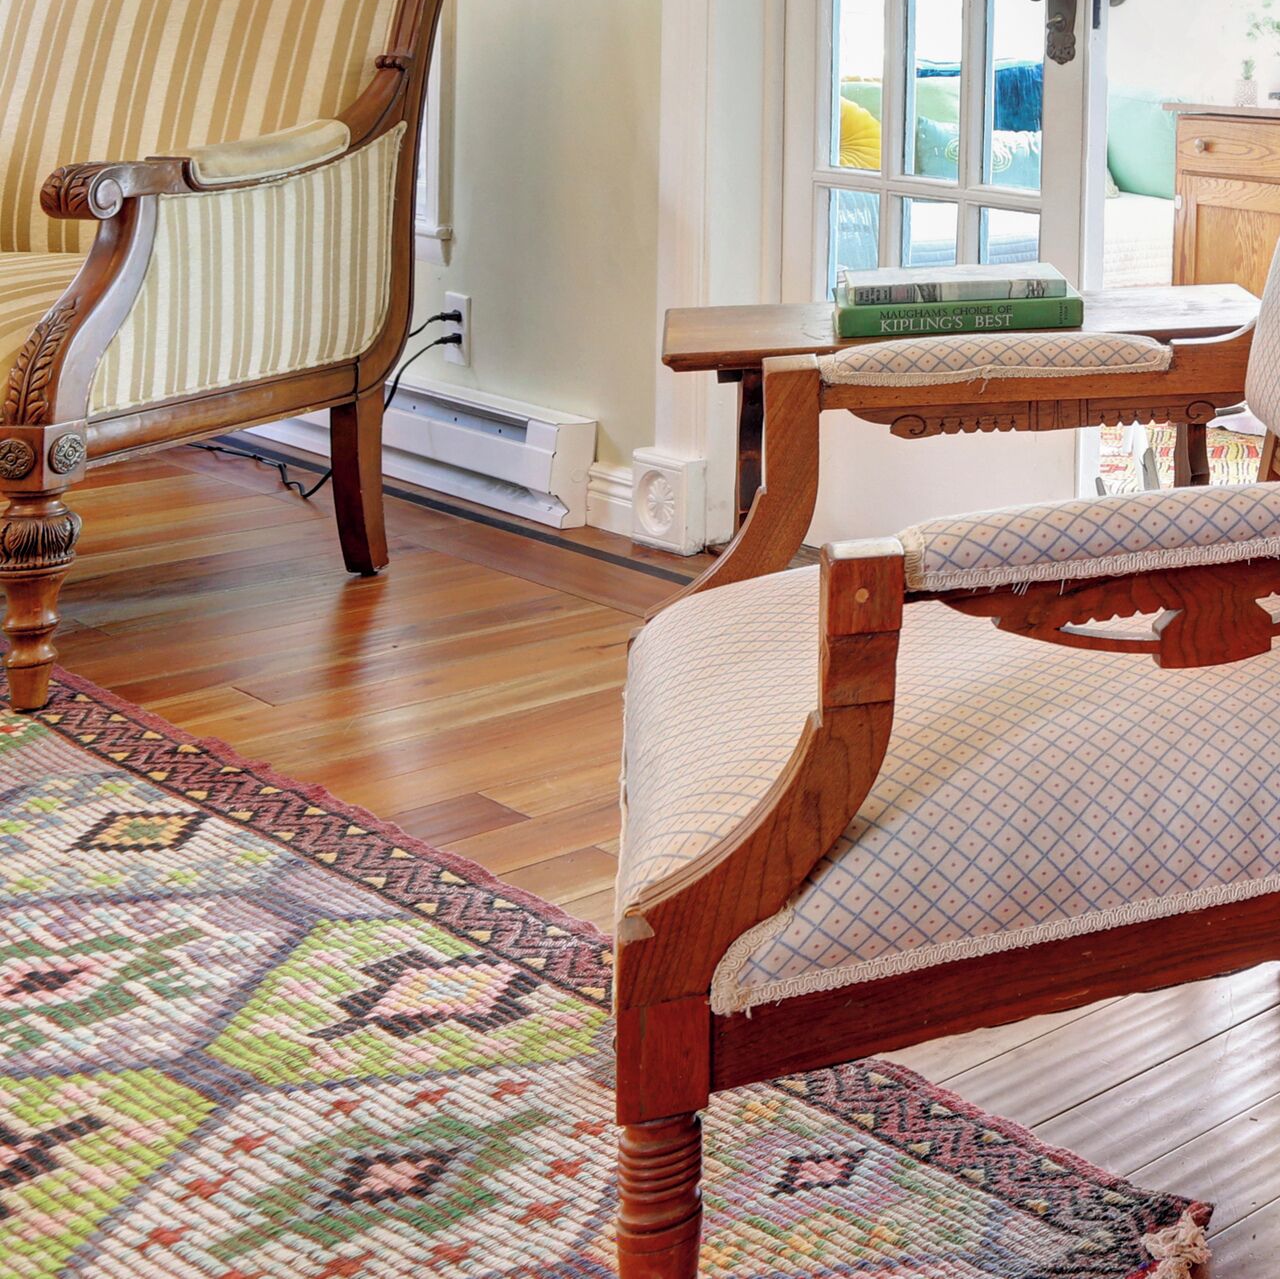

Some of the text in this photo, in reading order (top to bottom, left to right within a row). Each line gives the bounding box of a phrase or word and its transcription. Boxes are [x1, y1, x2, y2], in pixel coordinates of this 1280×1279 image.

[952, 305, 993, 317] CHOICE
[997, 304, 1013, 314] OF
[880, 314, 1014, 332] KIPLING'S BEST
